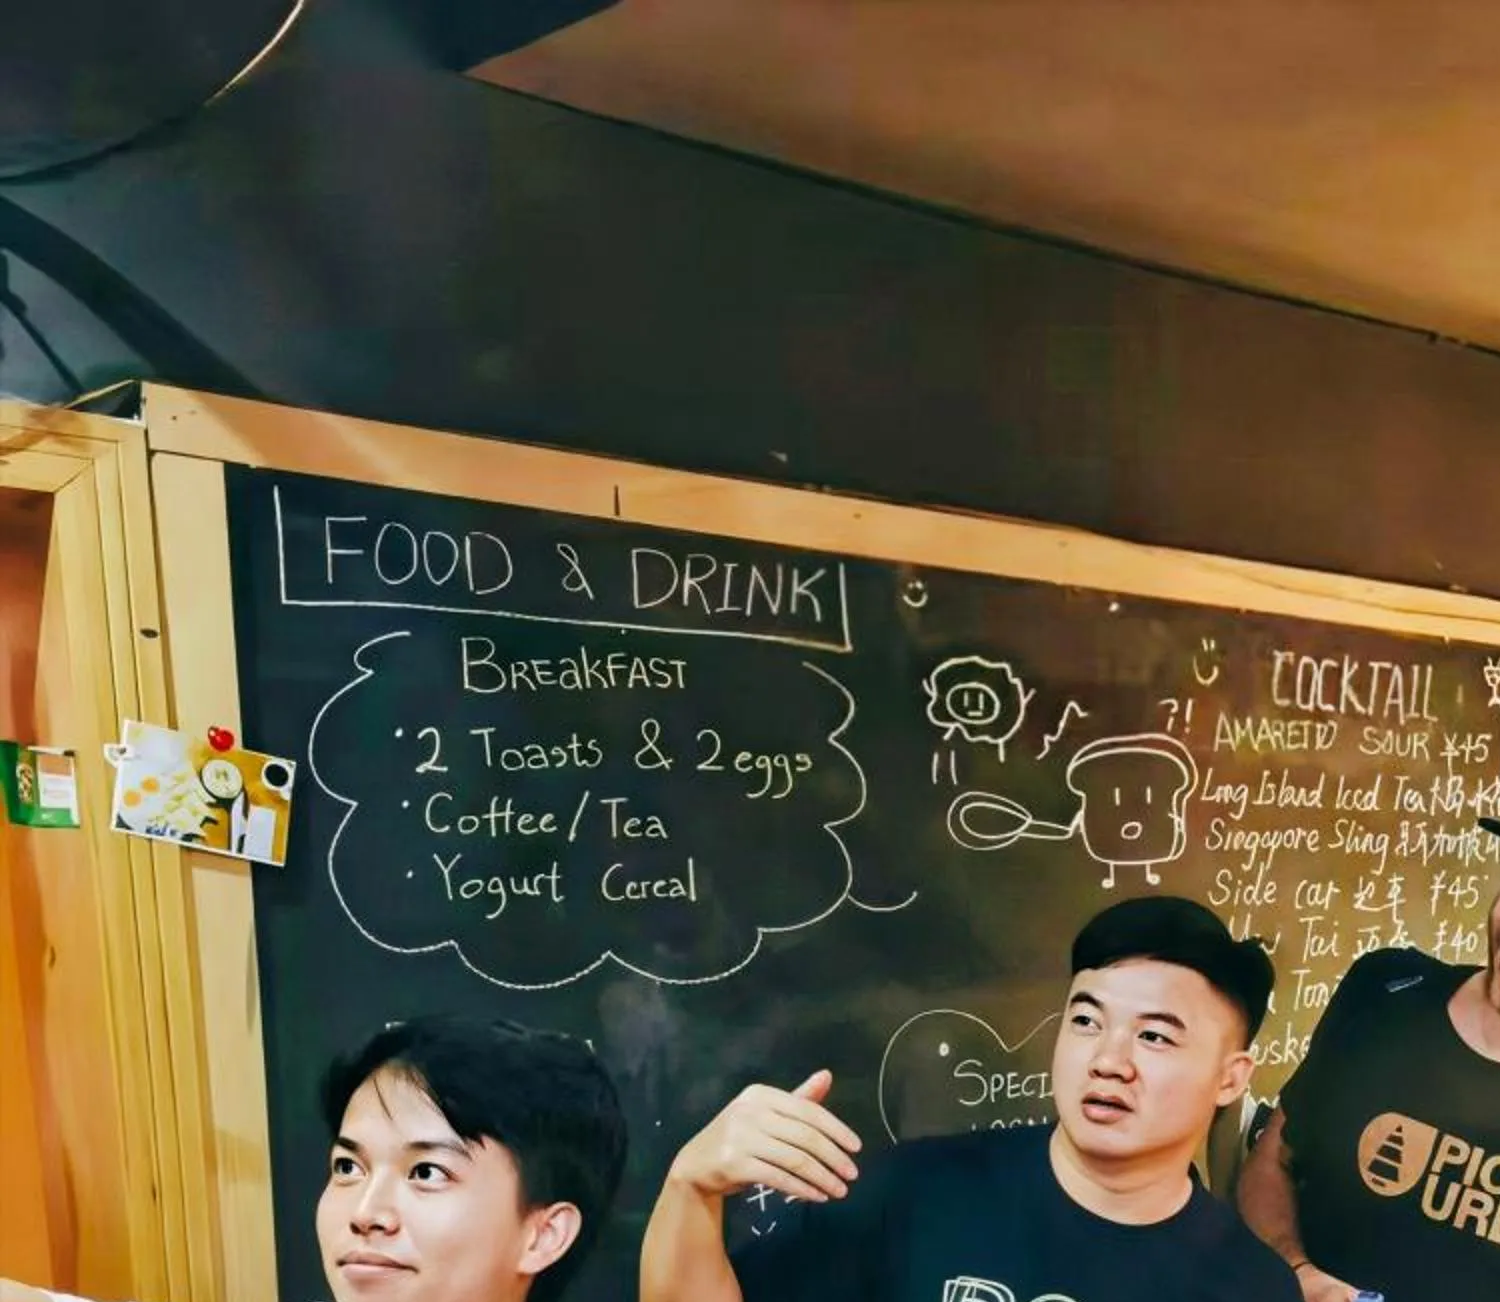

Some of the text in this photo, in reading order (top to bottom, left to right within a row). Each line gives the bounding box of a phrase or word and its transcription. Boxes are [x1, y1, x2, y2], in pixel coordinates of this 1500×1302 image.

[324, 516, 827, 622] FOOD & DRINK
[1272, 648, 1438, 725] COCKTAIL
[414, 727, 448, 774] 2
[469, 728, 604, 770] Toasts
[634, 718, 673, 769] &
[1359, 724, 1432, 762] SOUR
[1201, 767, 1249, 820] Long
[1252, 768, 1326, 809] Island
[1327, 818, 1391, 876] Sling
[434, 853, 697, 918] Yogurt Cereal
[1208, 867, 1278, 908] Side
[1300, 914, 1341, 963] Tai
